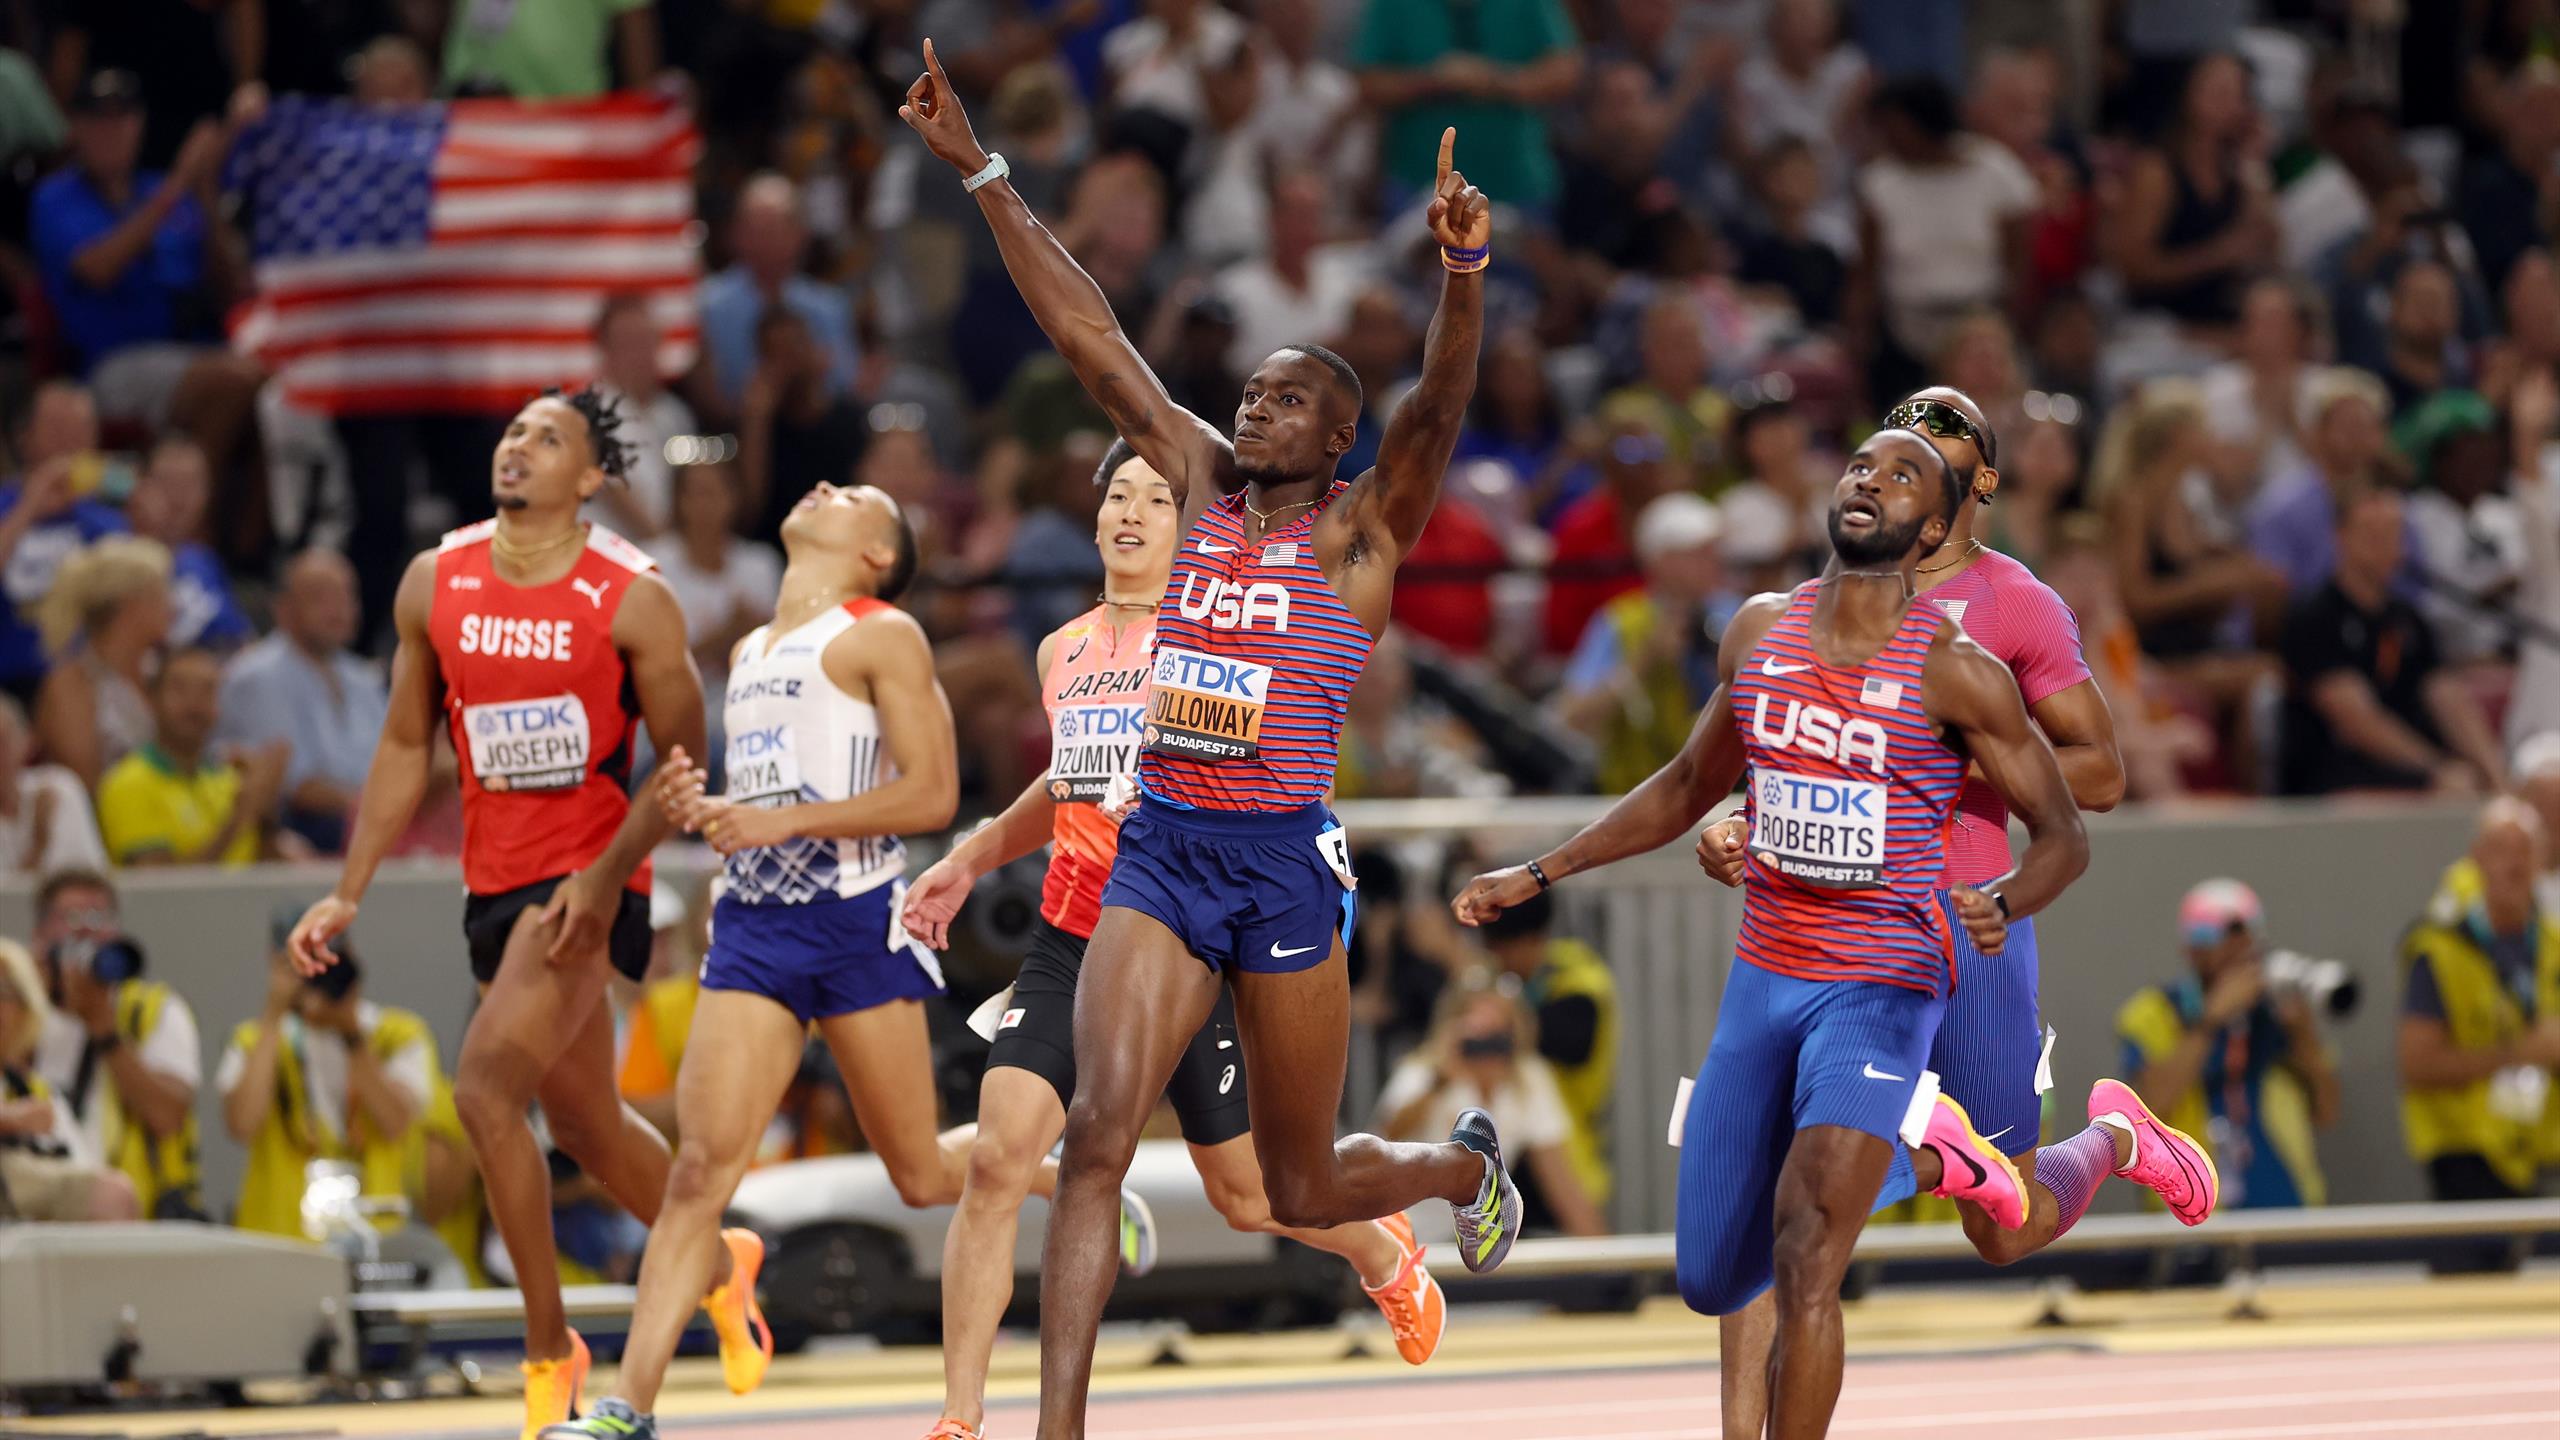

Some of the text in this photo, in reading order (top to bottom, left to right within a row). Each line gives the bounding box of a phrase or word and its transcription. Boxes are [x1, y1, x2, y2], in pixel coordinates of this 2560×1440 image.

[1179, 571, 1290, 632] USA
[1057, 668, 1149, 699] JAPAN
[1178, 655, 1258, 697] TDK
[496, 702, 574, 733] TDK
[1078, 707, 1147, 735] TDK
[1753, 692, 1888, 774] USA
[483, 734, 582, 769] JOSEPH
[736, 724, 786, 757] TDK
[1162, 733, 1246, 757] BUDAPEST 23
[1783, 779, 1873, 817] TDK
[1761, 813, 1874, 857] ROBERTS
[1781, 861, 1874, 881] BUDAPEST 23
